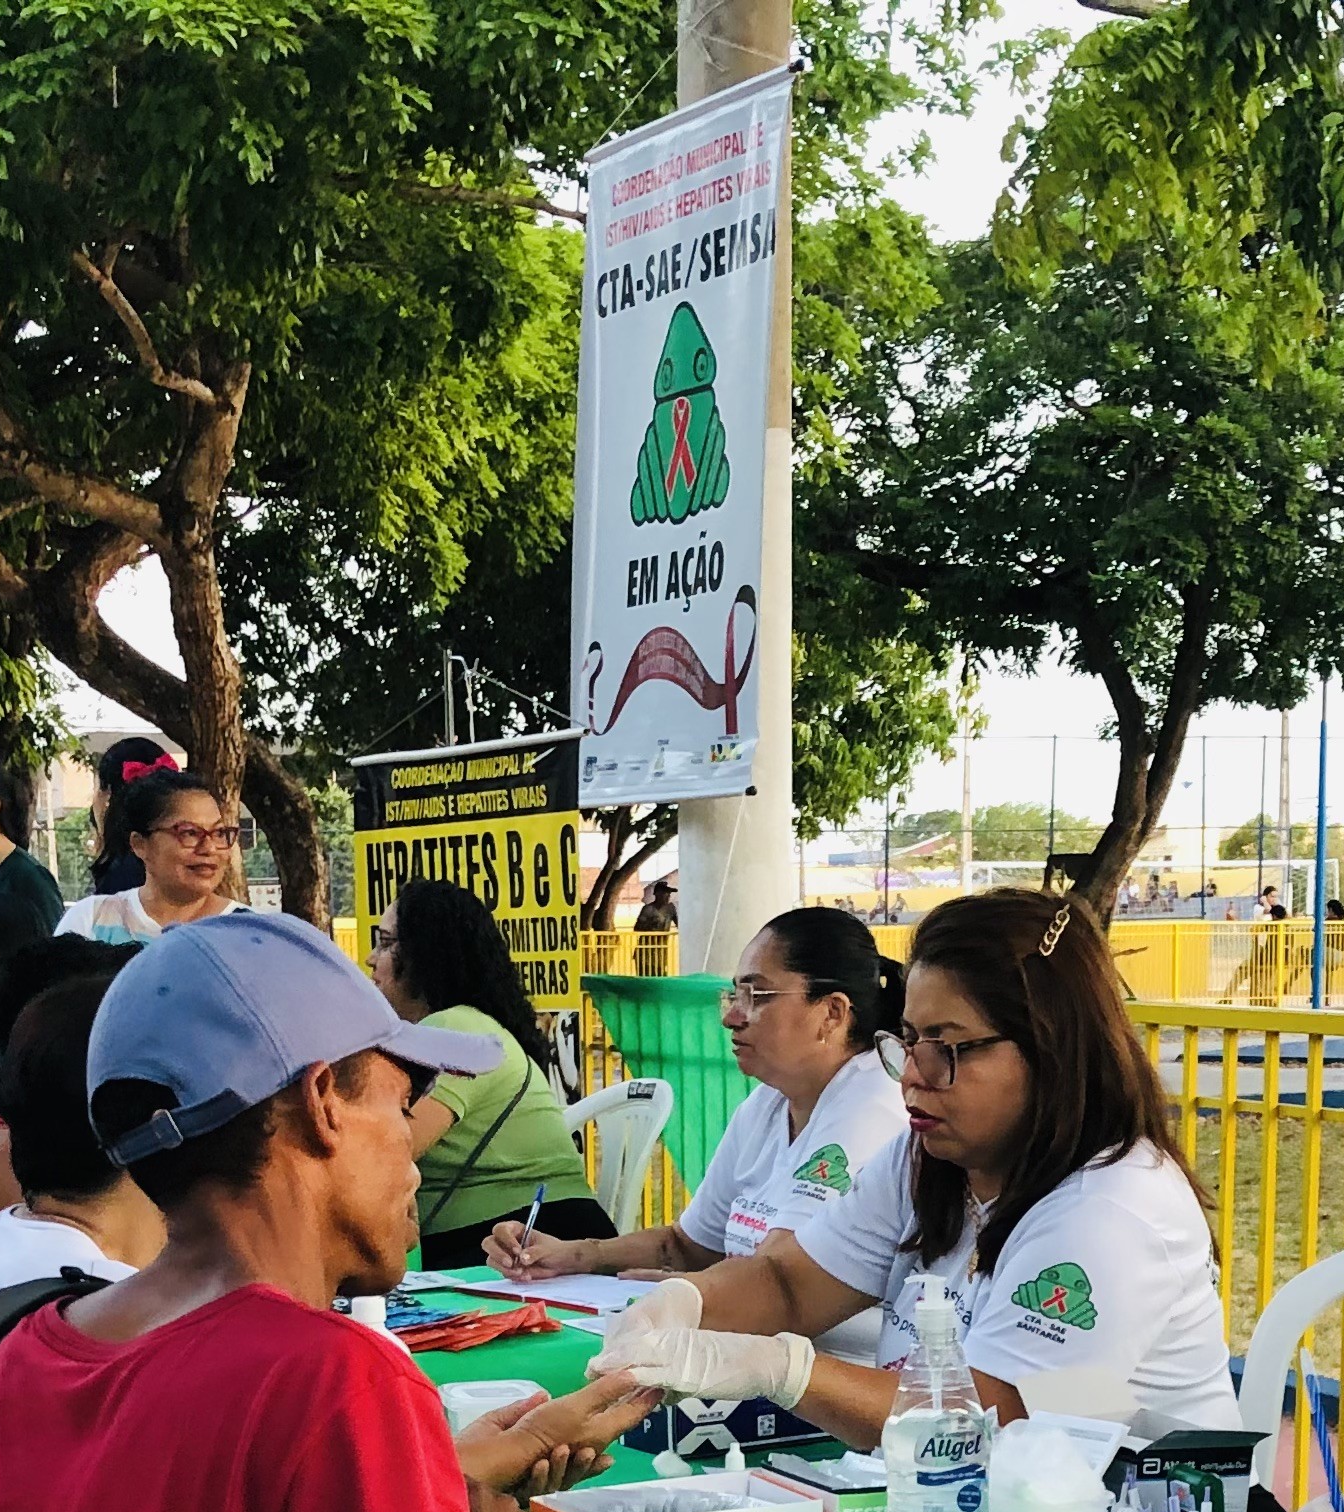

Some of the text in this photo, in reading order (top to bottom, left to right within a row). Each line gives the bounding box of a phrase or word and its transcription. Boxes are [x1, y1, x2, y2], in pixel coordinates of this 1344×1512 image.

[686, 130, 747, 176] MUNICIPAL
[676, 175, 733, 217] HEPATITES
[737, 160, 771, 196] VIRAIS
[627, 530, 724, 613] EM AÇÃO
[391, 752, 537, 789] COORDENAÇÃO MUNICIPAL DE
[448, 795, 455, 816] E
[457, 790, 509, 815] HEPATITES
[511, 784, 547, 809] VIRAIS
[506, 831, 524, 908] B
[534, 843, 550, 907] e
[560, 824, 576, 906] C
[1024, 1315, 1041, 1325] CTA
[920, 1435, 981, 1461] Allgel
